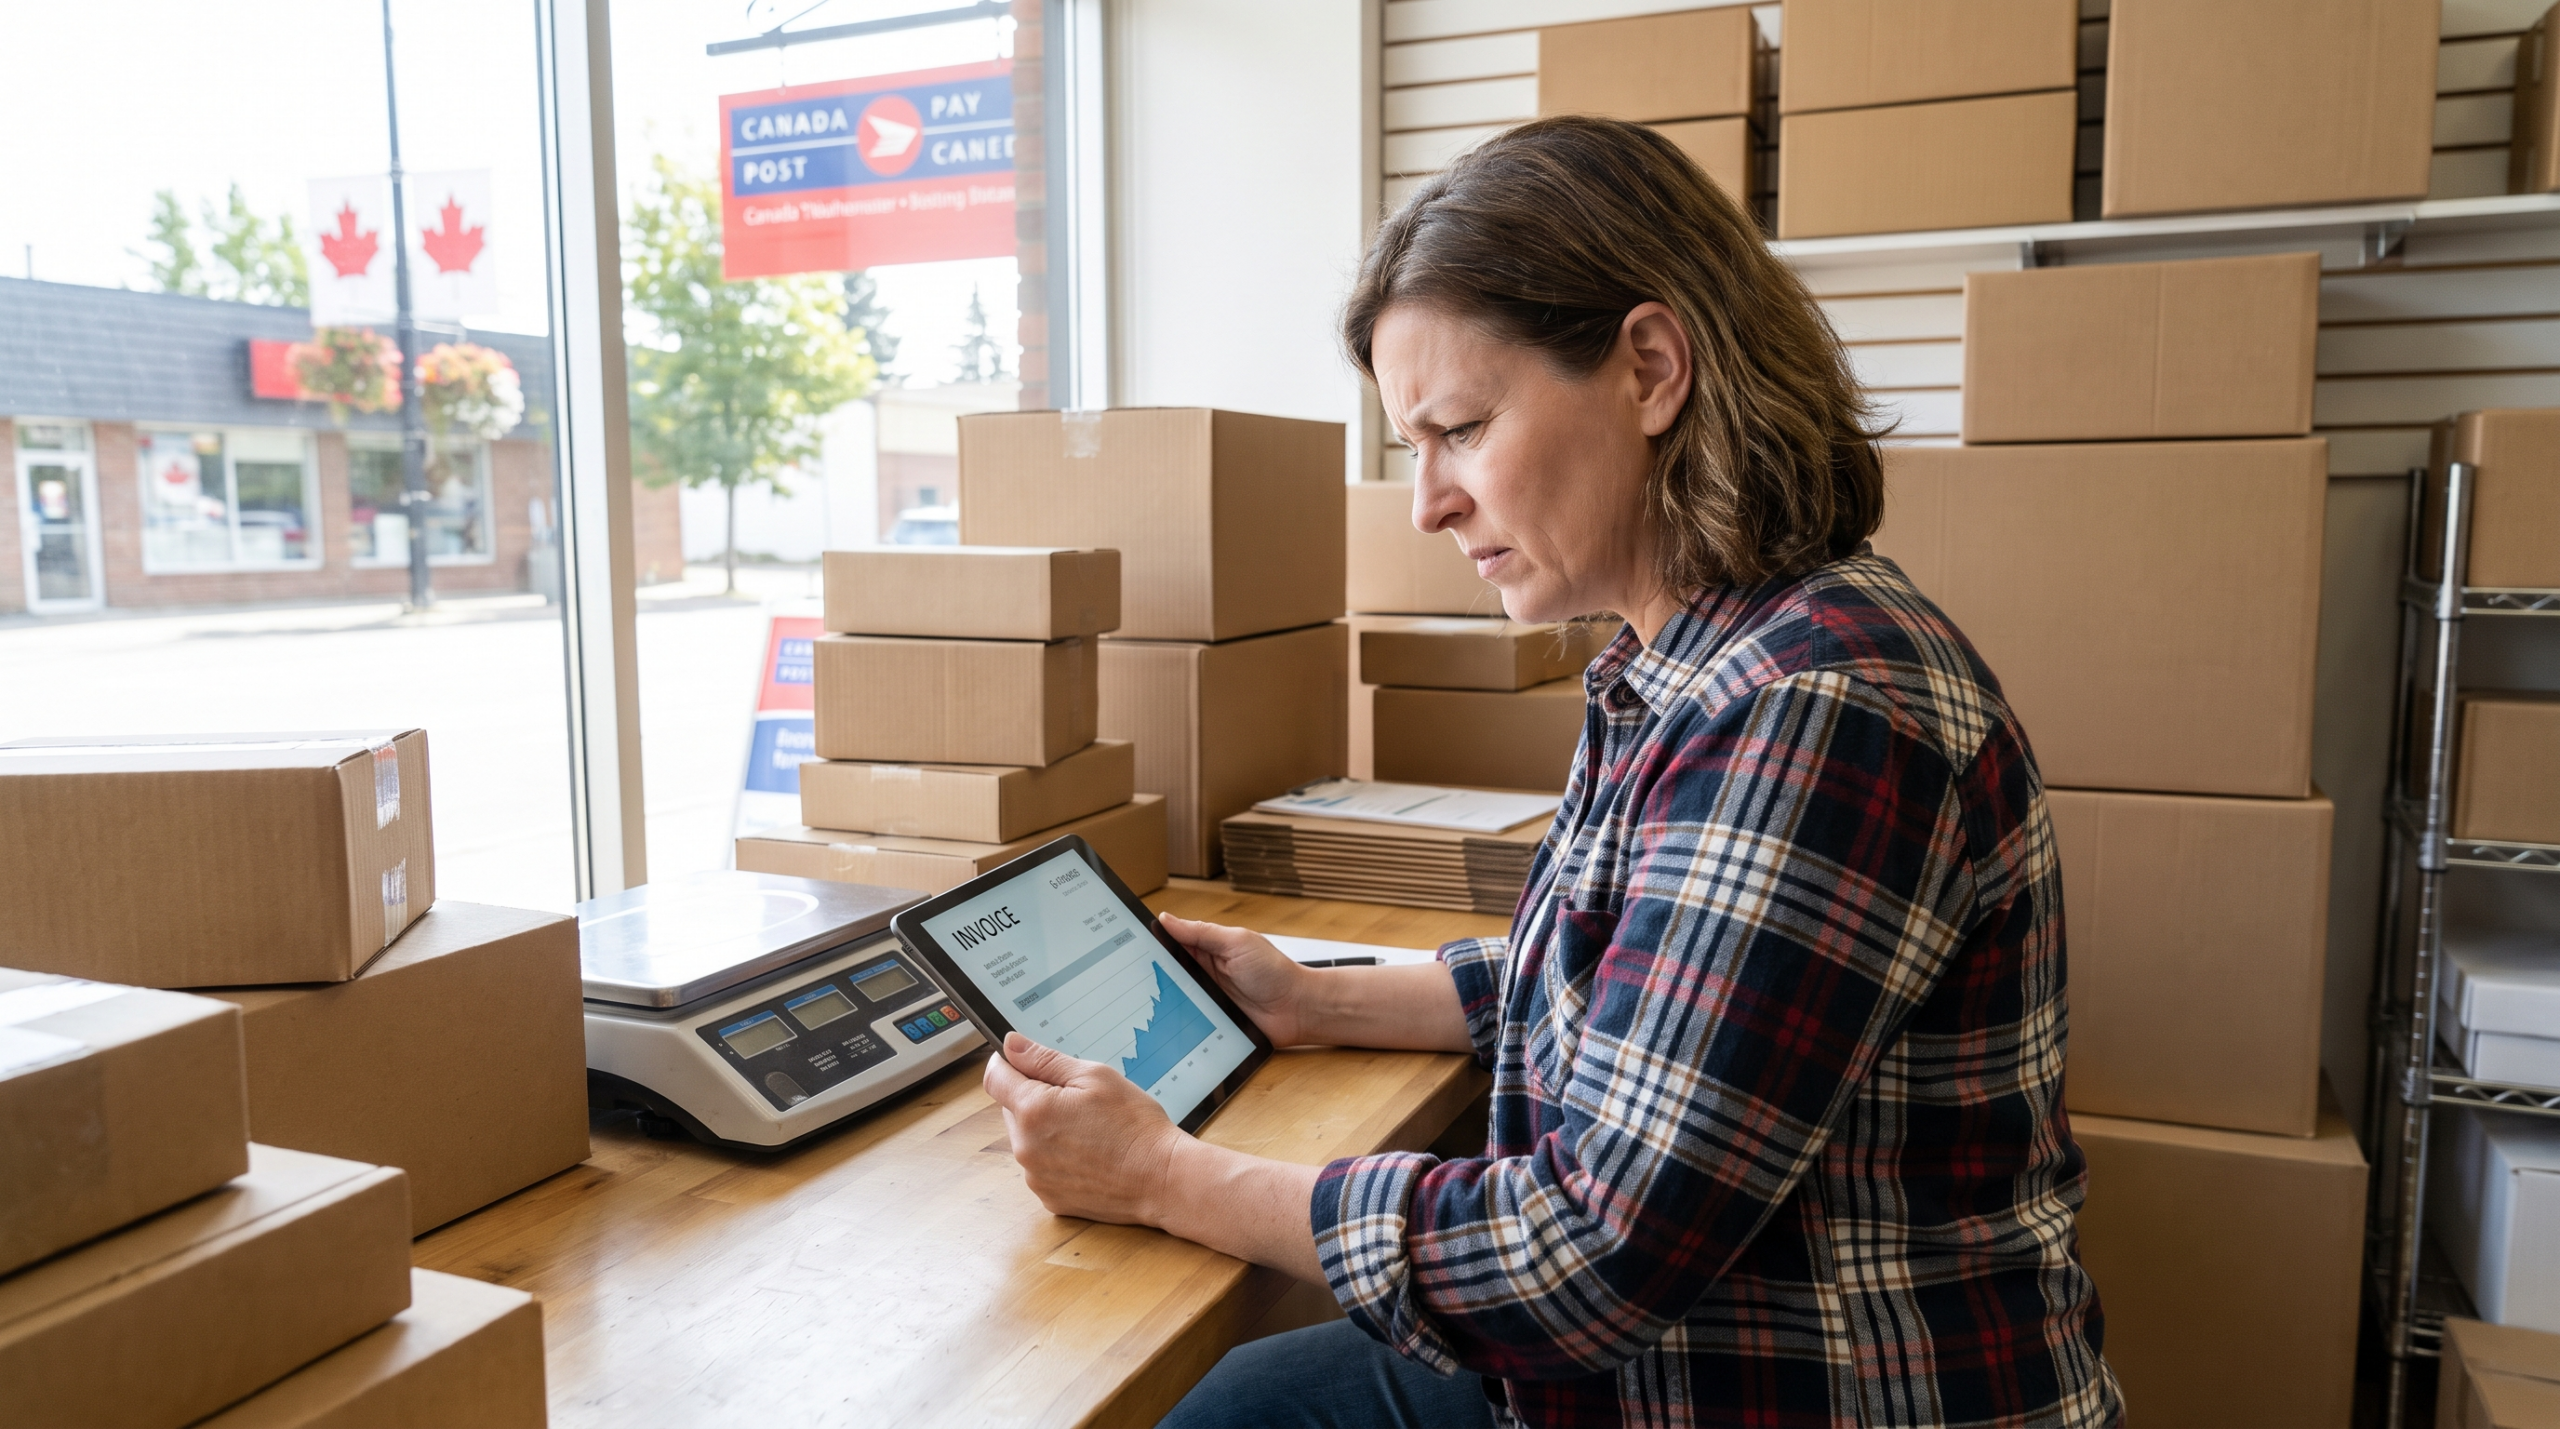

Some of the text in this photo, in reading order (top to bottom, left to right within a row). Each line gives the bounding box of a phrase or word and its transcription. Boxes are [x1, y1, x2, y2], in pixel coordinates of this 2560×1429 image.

[931, 92, 981, 120] PAY
[741, 107, 848, 142] CANADA
[743, 155, 808, 185] POST
[951, 905, 1021, 951] INVOICE
